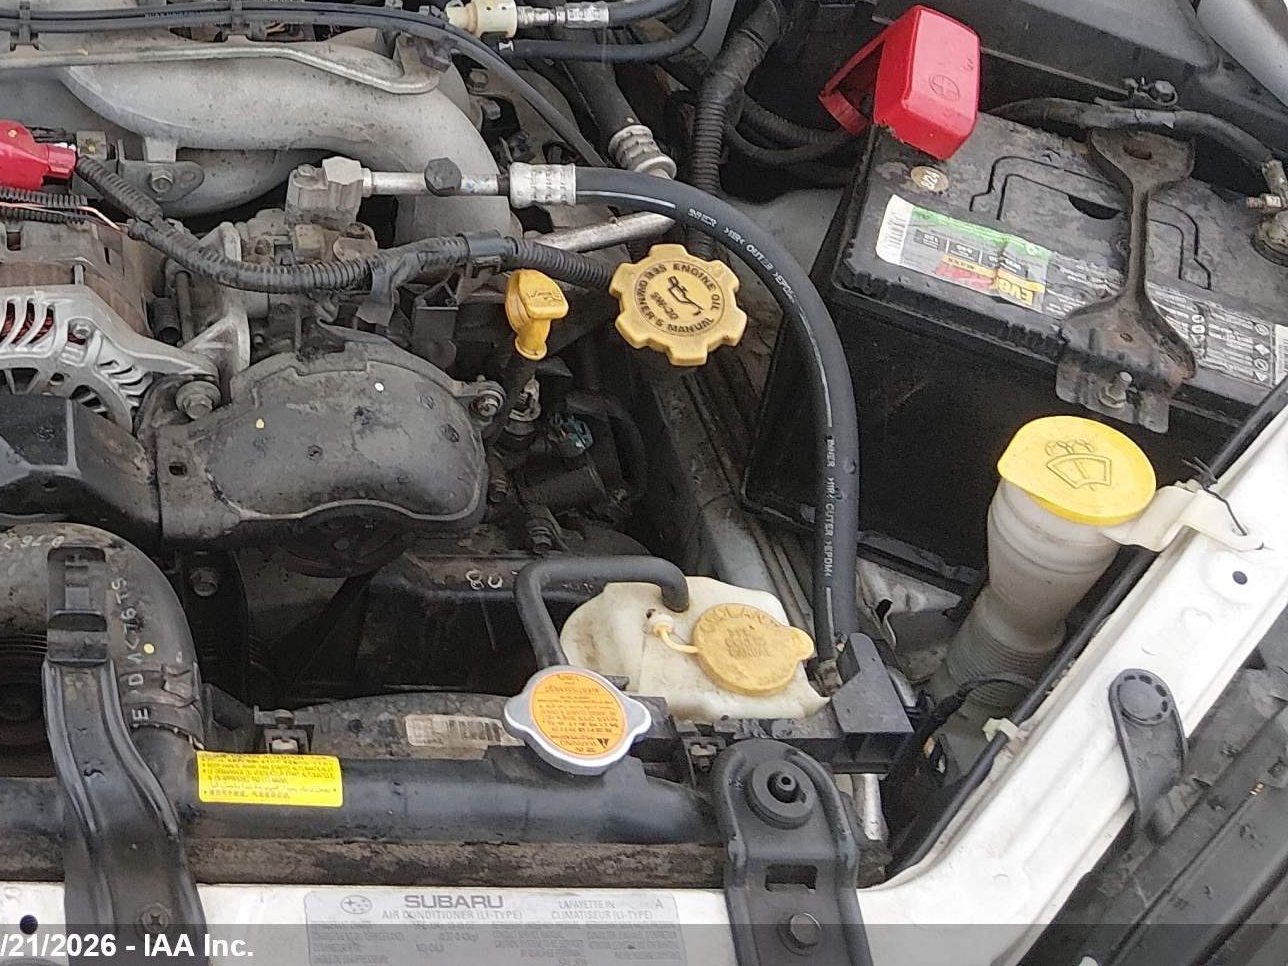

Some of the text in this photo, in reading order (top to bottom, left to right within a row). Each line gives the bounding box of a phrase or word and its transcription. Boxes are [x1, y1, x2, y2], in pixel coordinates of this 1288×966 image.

[672, 262, 721, 312] ENGINE OIL
[666, 316, 715, 334] MANUAL
[20, 534, 48, 550] 76
[404, 895, 503, 909] SUBARU
[655, 898, 664, 910] A
[382, 910, 400, 920] AIR
[402, 910, 474, 920] CONDITIONER
